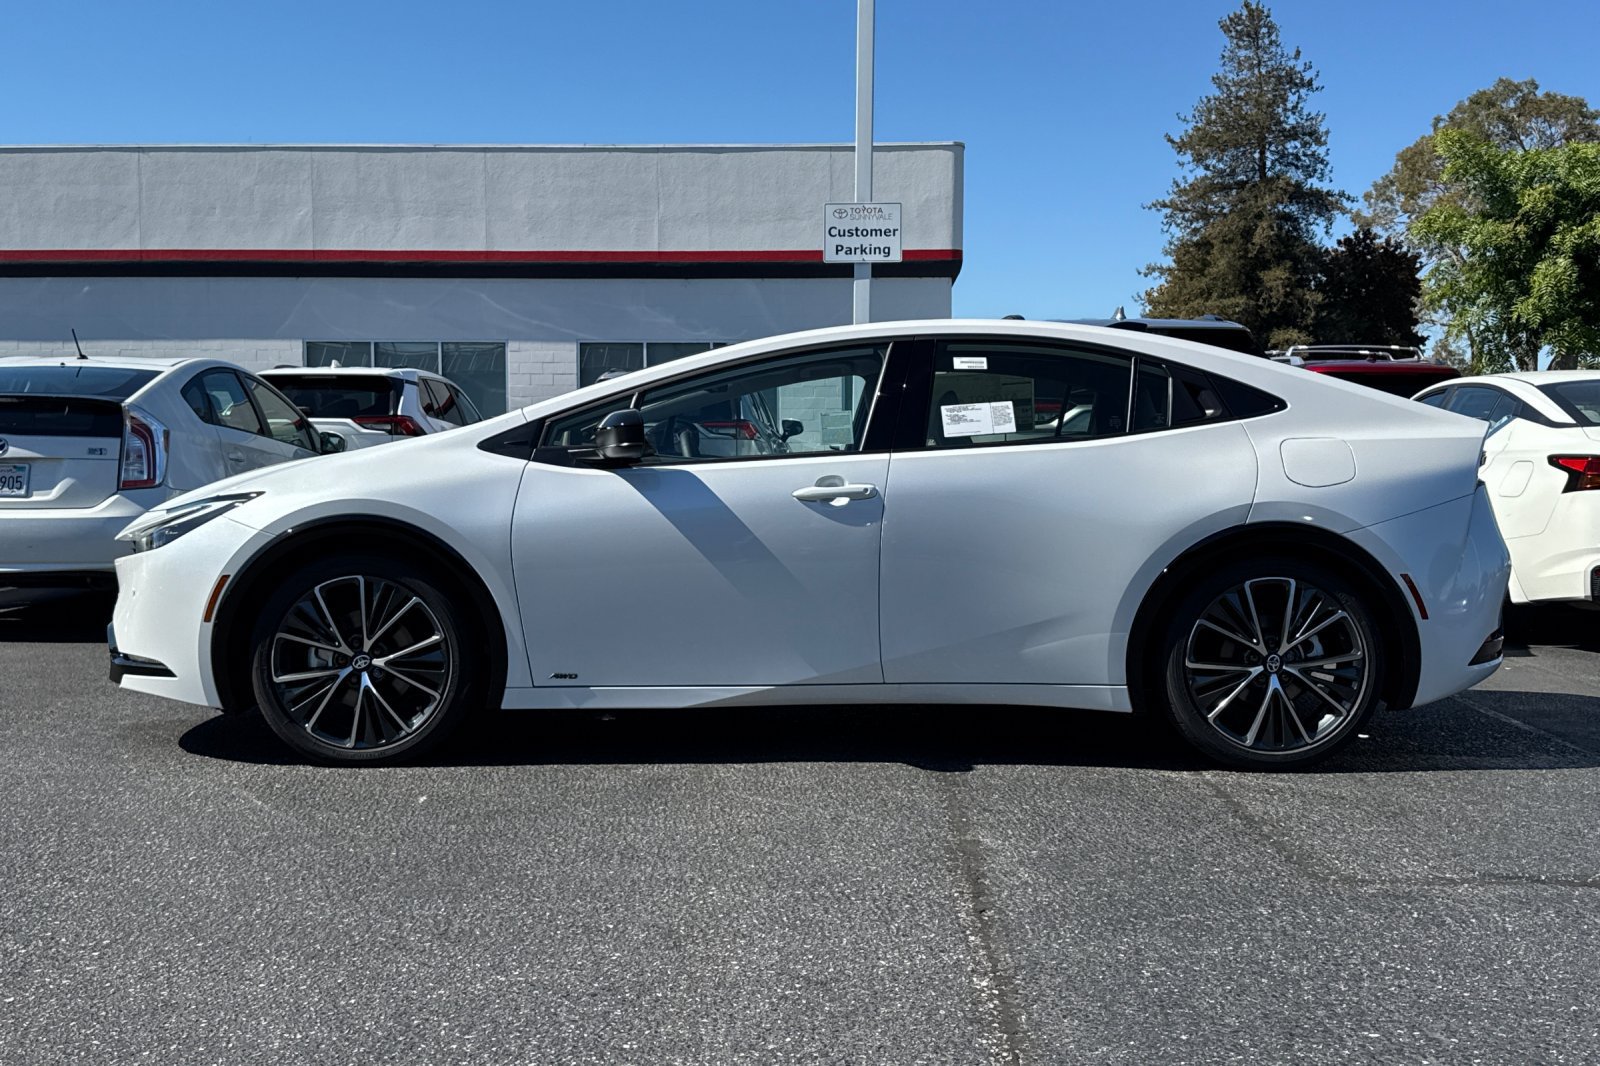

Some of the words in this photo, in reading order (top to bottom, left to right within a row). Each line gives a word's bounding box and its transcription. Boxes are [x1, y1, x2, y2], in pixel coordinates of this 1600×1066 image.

[828, 226, 899, 238] Customer
[835, 243, 891, 258] Parking
[0, 475, 23, 490] 905
